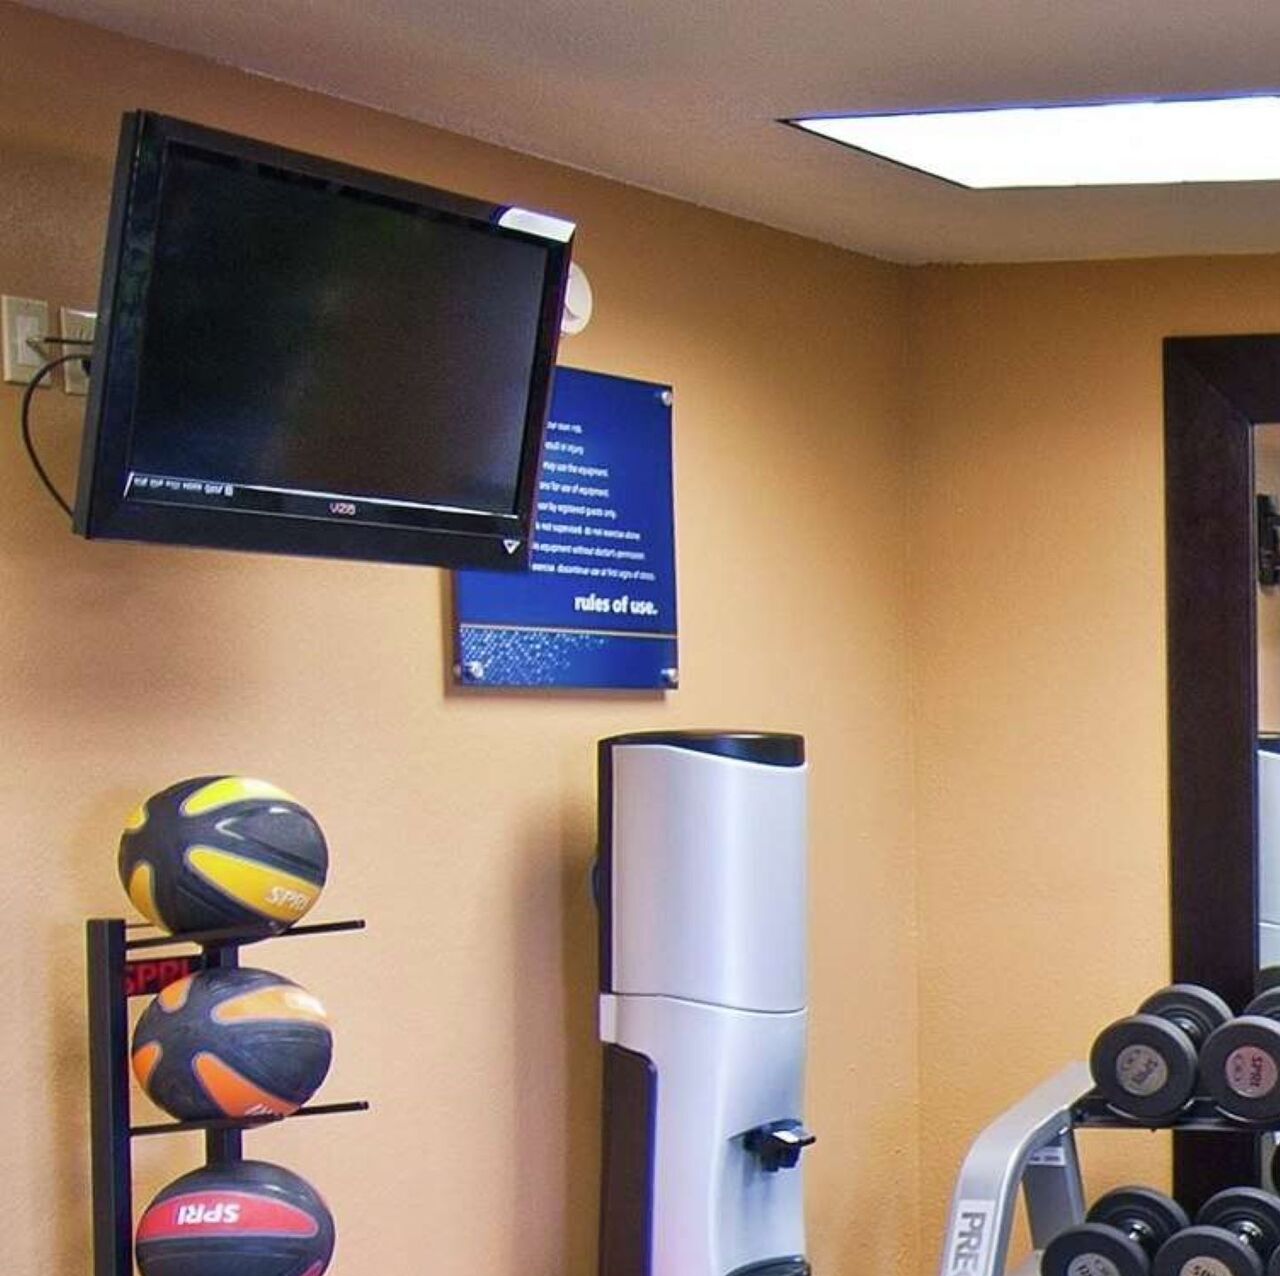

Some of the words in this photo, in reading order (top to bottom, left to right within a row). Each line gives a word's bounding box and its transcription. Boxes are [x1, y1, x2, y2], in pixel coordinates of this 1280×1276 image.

[574, 592, 610, 612] rules
[612, 595, 629, 613] of
[630, 599, 659, 616] use.
[176, 1202, 241, 1226] SPRI
